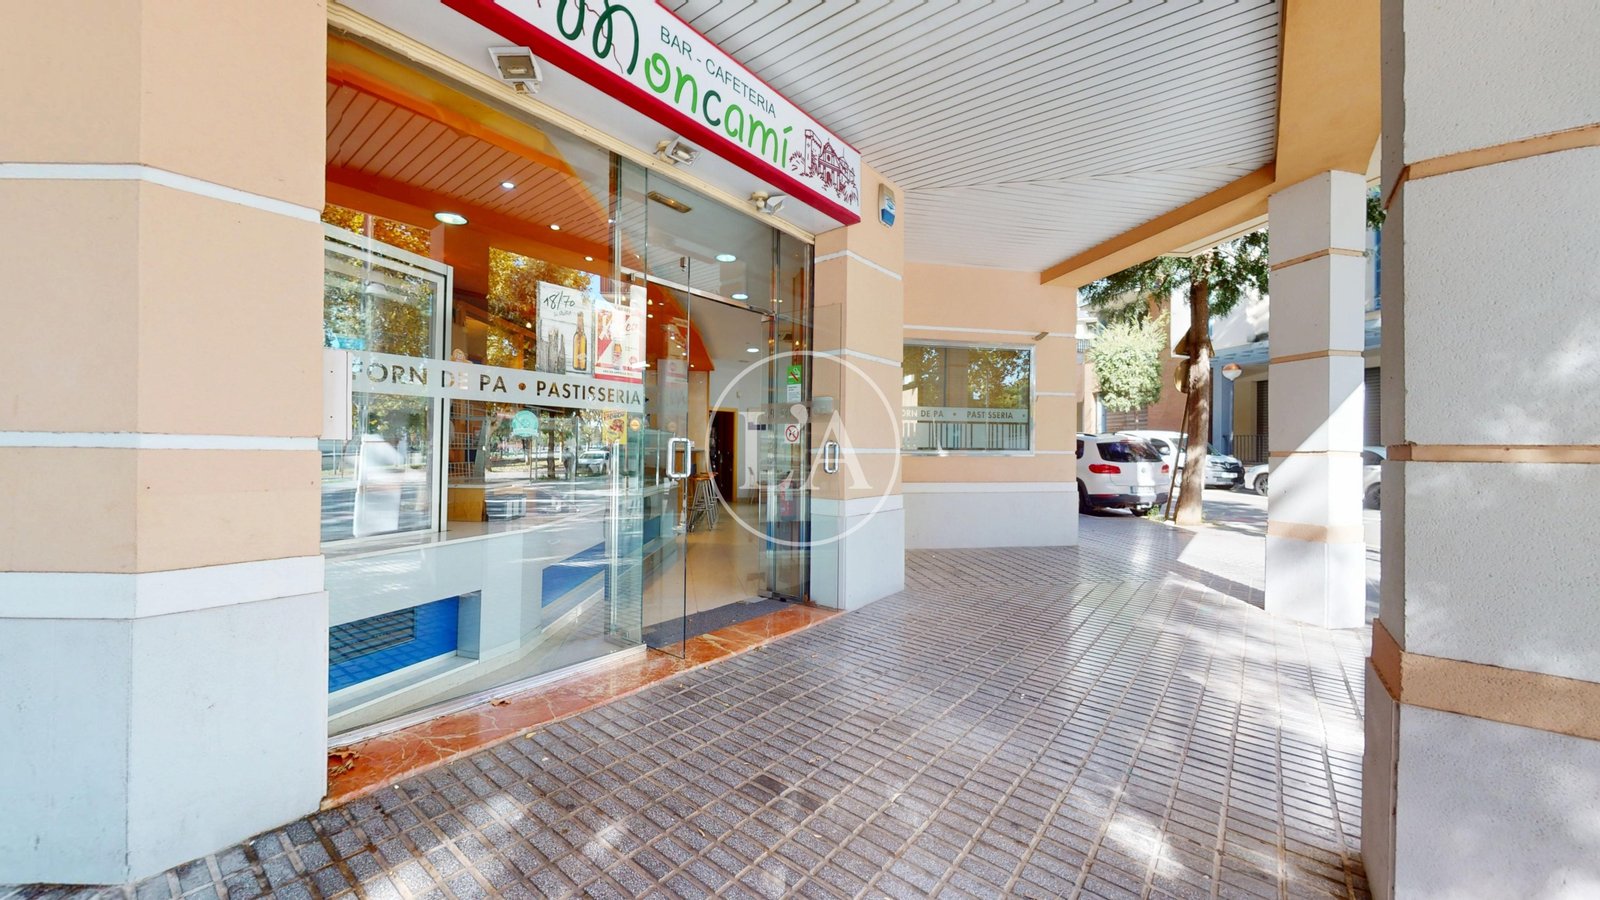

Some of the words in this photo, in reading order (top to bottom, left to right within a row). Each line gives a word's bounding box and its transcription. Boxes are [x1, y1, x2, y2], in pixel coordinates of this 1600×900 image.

[660, 25, 692, 60] BAR
[705, 58, 776, 118] CAFETERIA
[543, 290, 576, 310] 18/70
[441, 370, 468, 390] DE
[480, 374, 507, 394] PA
[537, 381, 641, 405] PASTISSERIA
[920, 410, 931, 418] DE
[933, 410, 944, 418] PA
[966, 410, 1013, 419] PASTSSERIA
